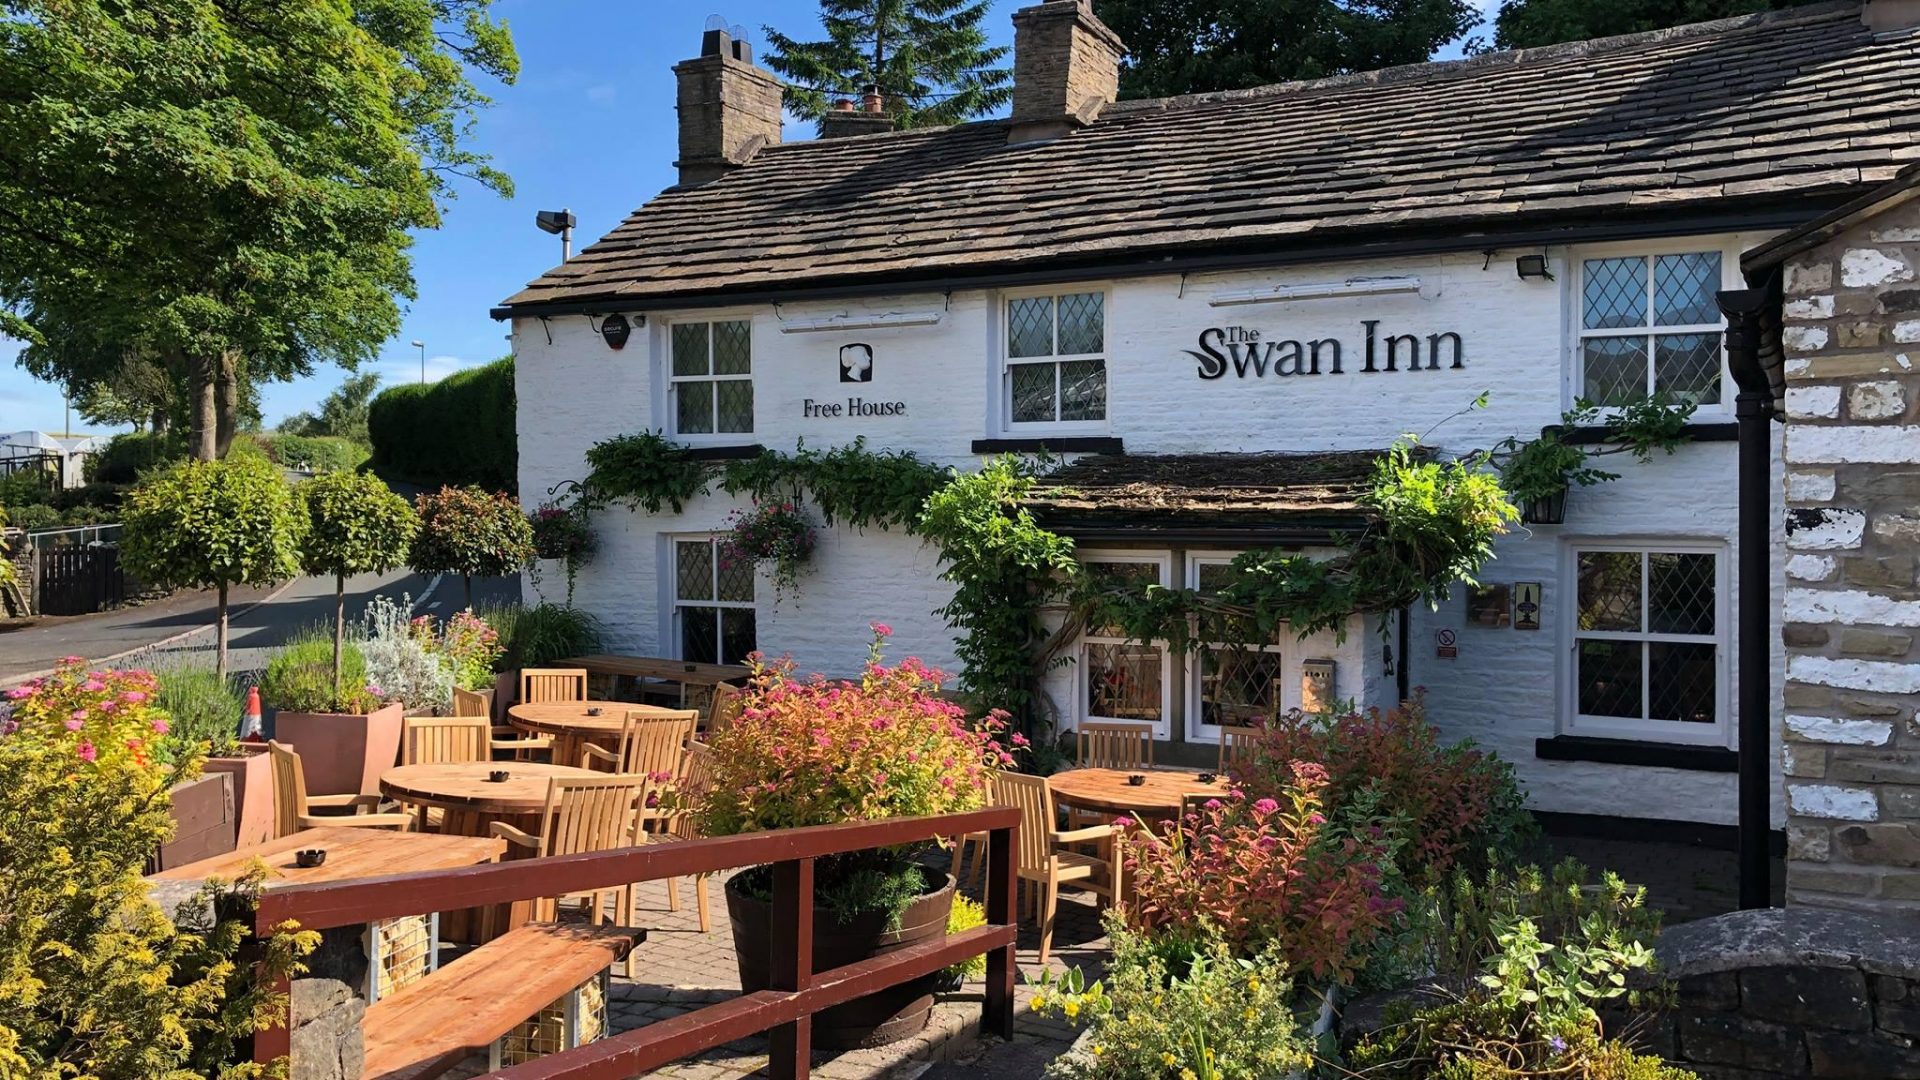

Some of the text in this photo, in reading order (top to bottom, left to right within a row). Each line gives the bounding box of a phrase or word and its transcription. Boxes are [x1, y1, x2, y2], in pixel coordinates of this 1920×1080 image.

[1226, 326, 1261, 343] The
[1184, 320, 1466, 380] Swan Inn
[803, 397, 906, 418] Free House
